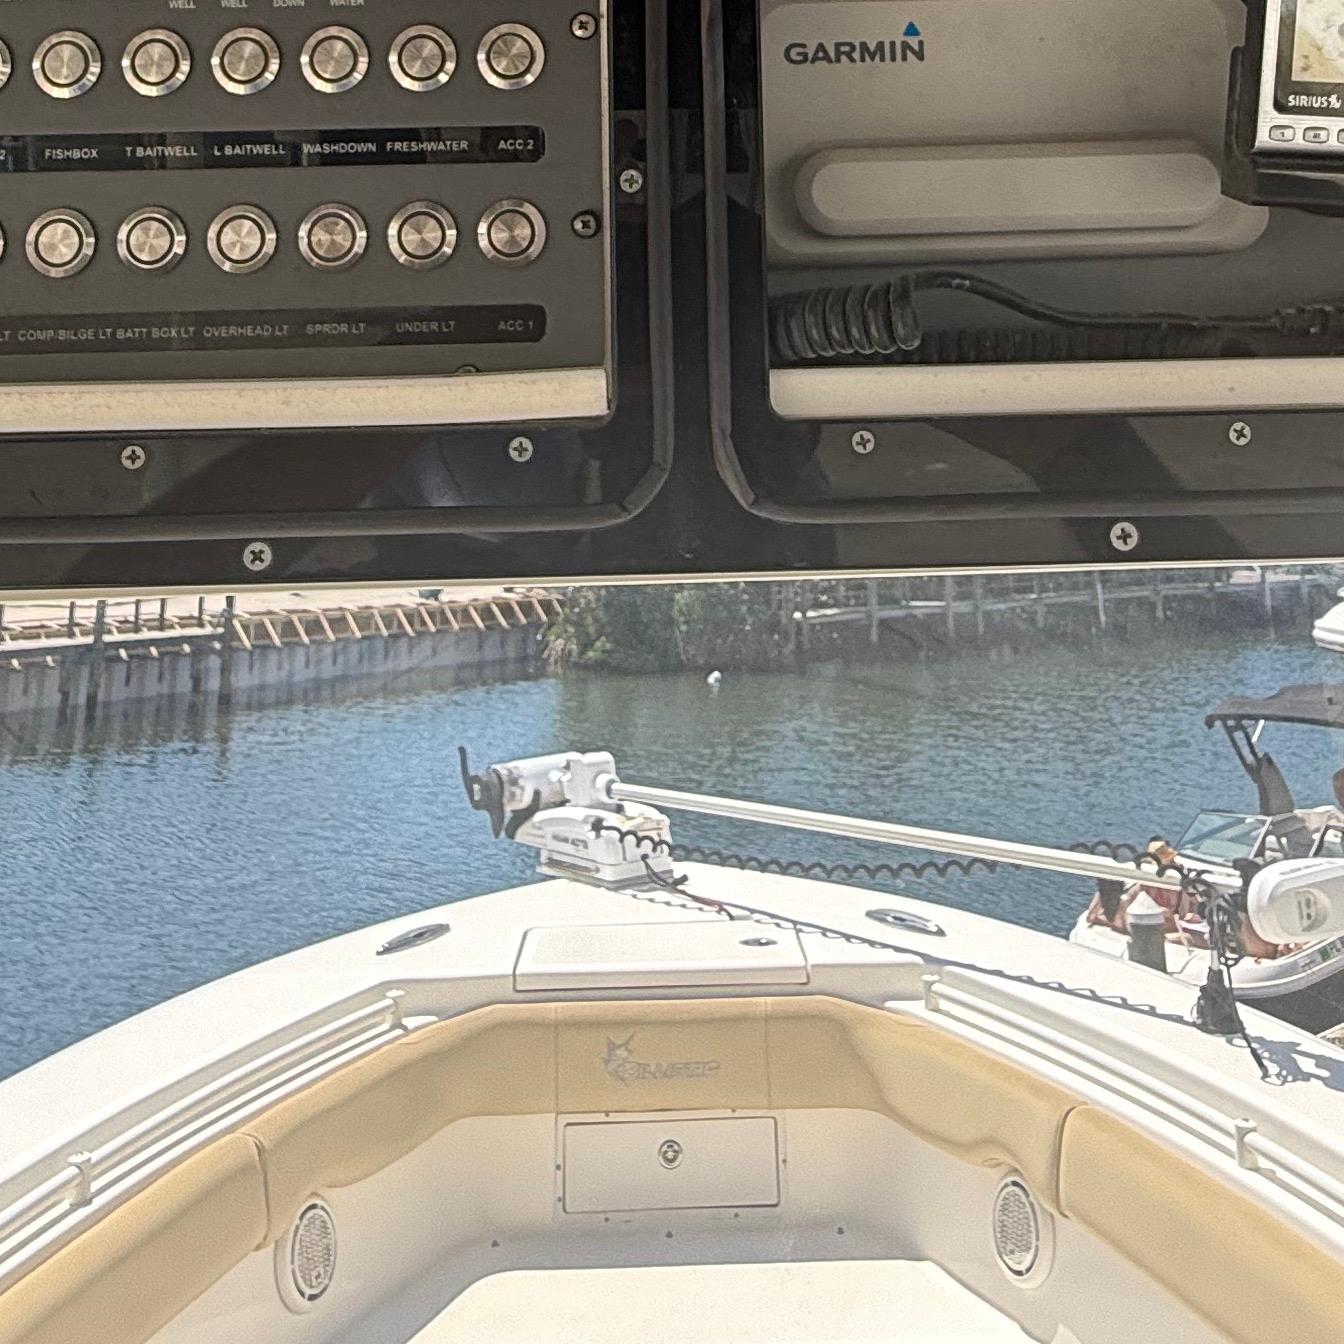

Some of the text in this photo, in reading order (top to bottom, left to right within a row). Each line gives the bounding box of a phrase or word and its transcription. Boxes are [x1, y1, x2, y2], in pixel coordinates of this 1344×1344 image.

[169, 0, 196, 10] WELL
[783, 39, 925, 65] GARMIN
[1287, 94, 1328, 108] SIRIUS
[214, 144, 286, 157] L BAITWELL
[302, 142, 377, 154] WASHDOWN
[386, 140, 469, 152] FRESHWATER
[498, 139, 535, 151] ACC 2
[44, 148, 99, 160] FISHBOX
[125, 145, 198, 158] T BAITWELL
[203, 325, 289, 338] OVERHEAD LT
[305, 323, 367, 335] SPRDR LT
[396, 321, 456, 333] UNDER LT
[497, 321, 524, 332] ACC
[58, 329, 95, 341] BILGE
[98, 329, 113, 340] LT
[116, 327, 195, 340] BATT BOX LT
